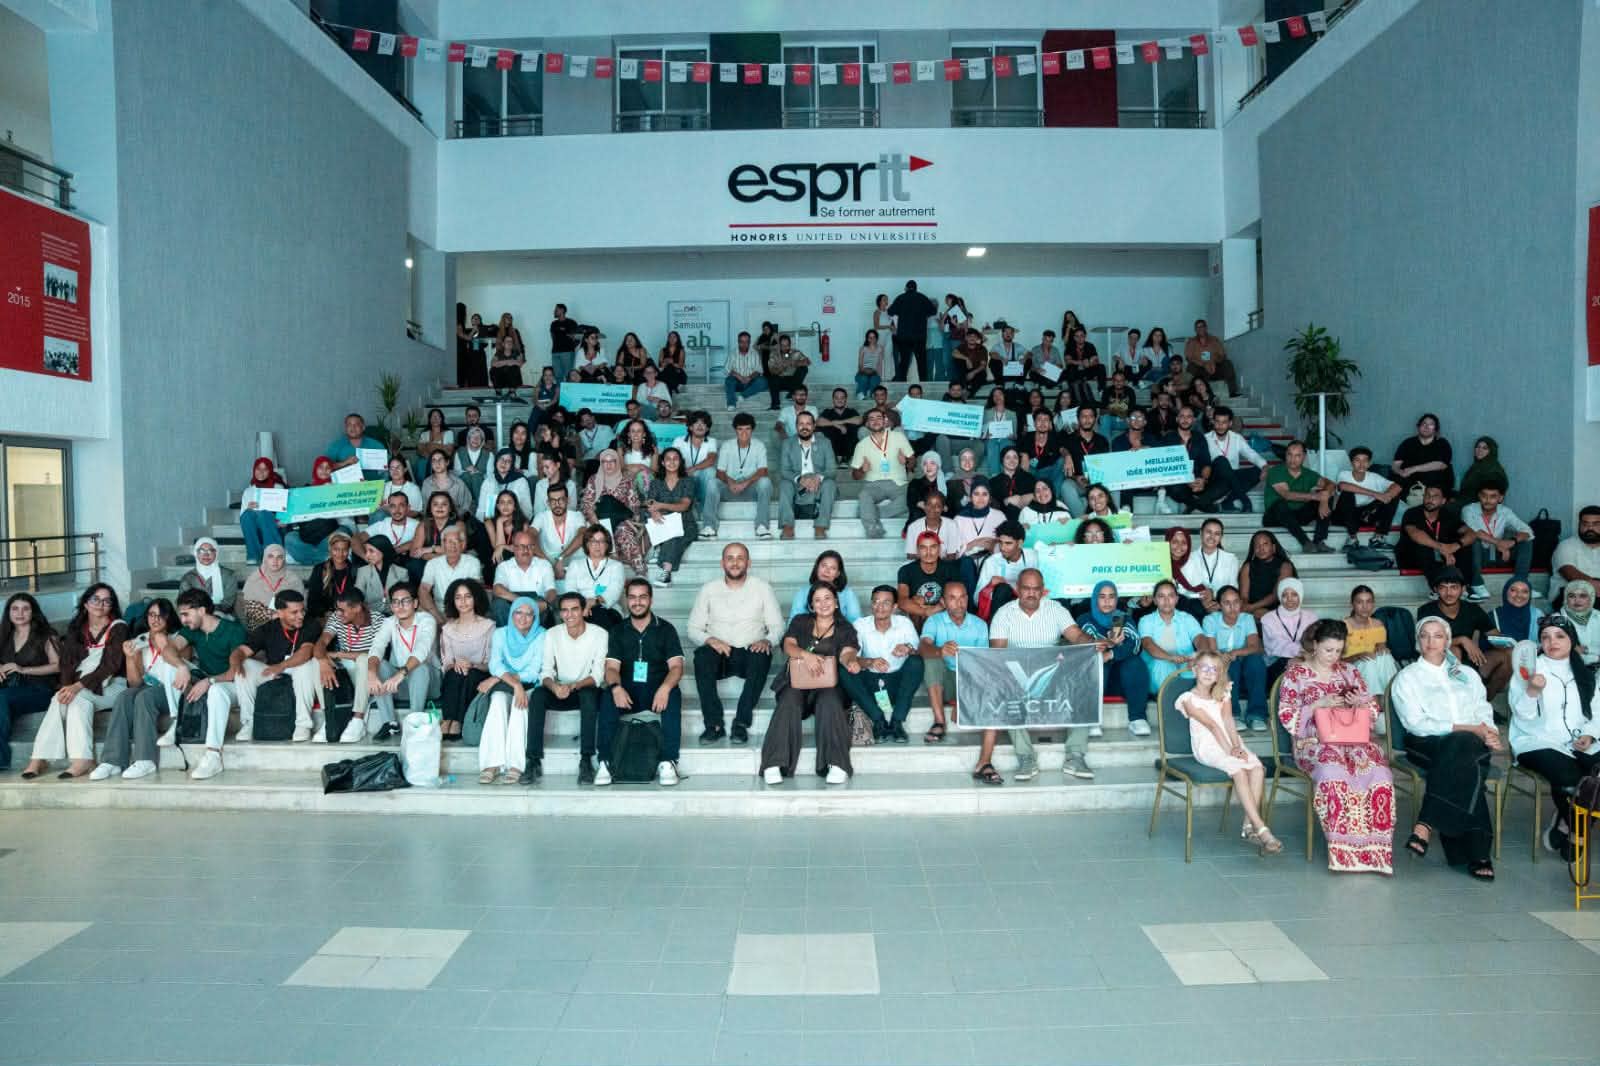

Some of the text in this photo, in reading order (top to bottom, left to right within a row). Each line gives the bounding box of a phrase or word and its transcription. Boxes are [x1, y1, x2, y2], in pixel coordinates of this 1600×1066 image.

[728, 153, 911, 217] esprit
[820, 206, 936, 217] Se former autrement
[730, 231, 937, 242] HONORIS UNITED UNIVERSITIES
[7, 291, 31, 307] 2015
[673, 320, 712, 330] Samsung
[1145, 455, 1185, 466] MEILLEURE
[1126, 464, 1188, 477] IDÉE INNOVANTE
[337, 489, 378, 498] MEILLEURE
[1092, 564, 1161, 574] PRIX DU PUBLIC
[987, 699, 1074, 713] VECTA
